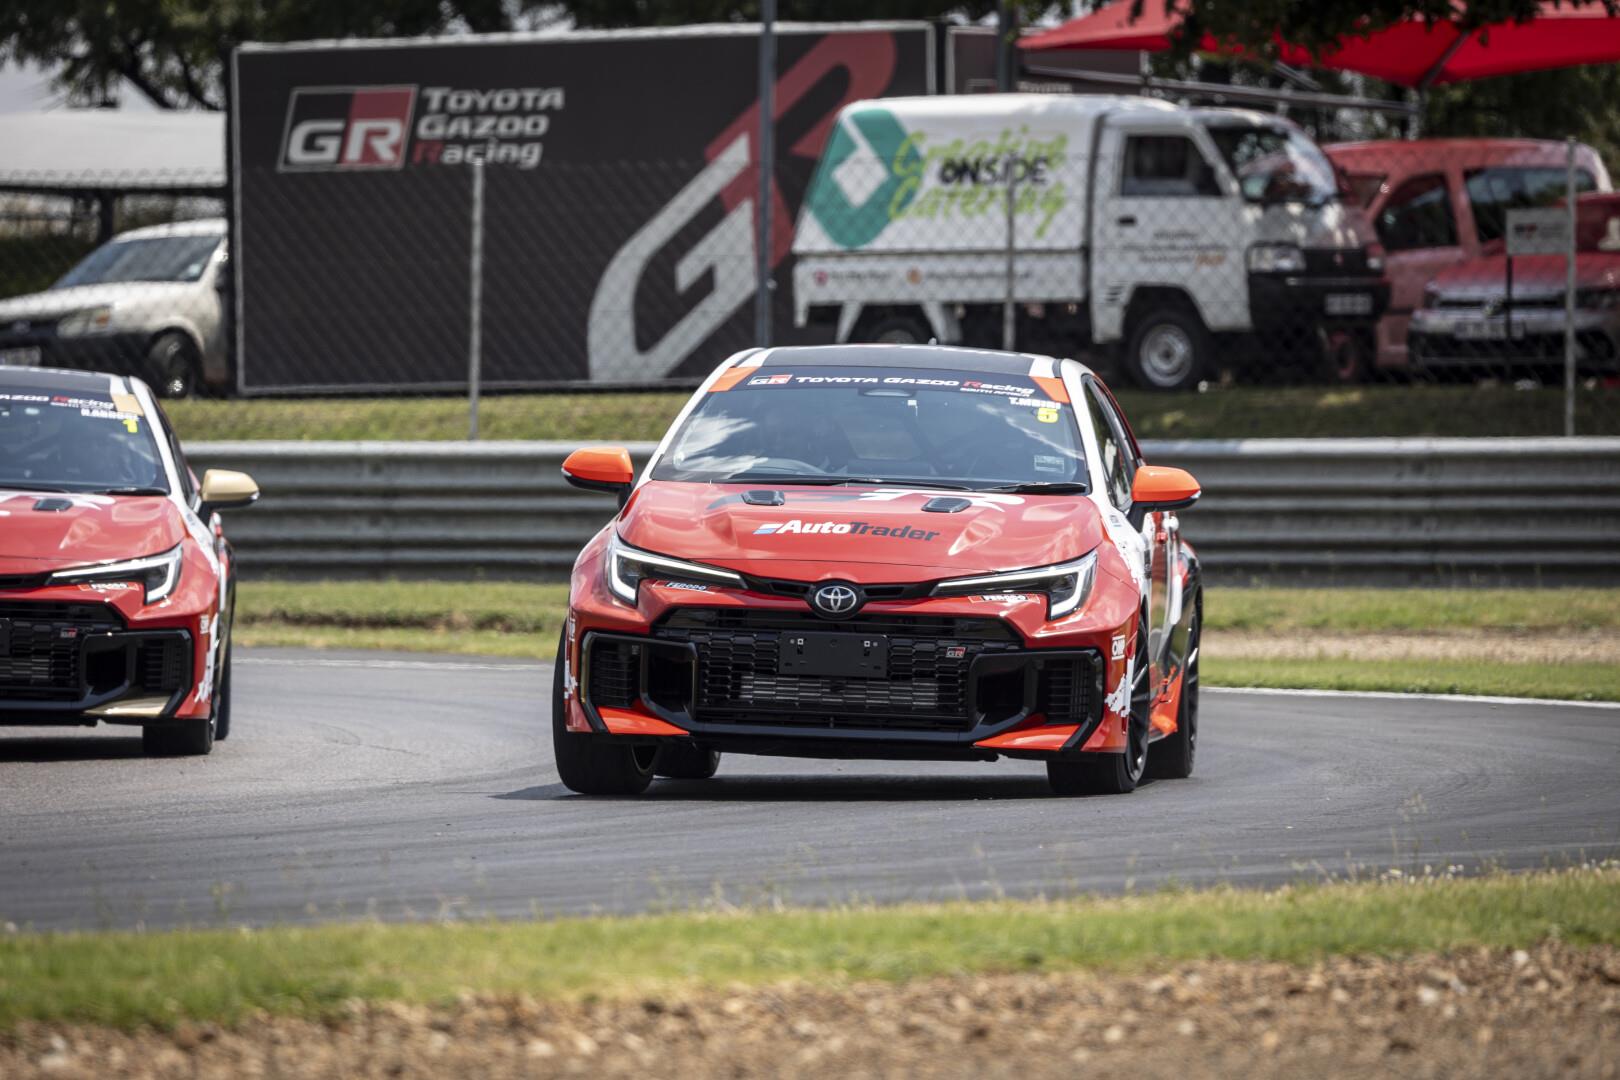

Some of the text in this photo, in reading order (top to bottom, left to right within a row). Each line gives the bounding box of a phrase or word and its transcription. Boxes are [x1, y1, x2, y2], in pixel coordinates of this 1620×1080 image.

[421, 86, 565, 112] TOYOTA
[416, 114, 550, 140] GAZOO
[287, 117, 405, 165] GR
[412, 141, 543, 170] Racing
[938, 155, 1049, 185] ONSIDE
[752, 376, 786, 384] GR
[883, 377, 960, 386] GAZOO
[963, 380, 1035, 395] Racing
[122, 418, 138, 433] 1
[1037, 407, 1059, 424] 5
[776, 519, 941, 541] AutoTrader
